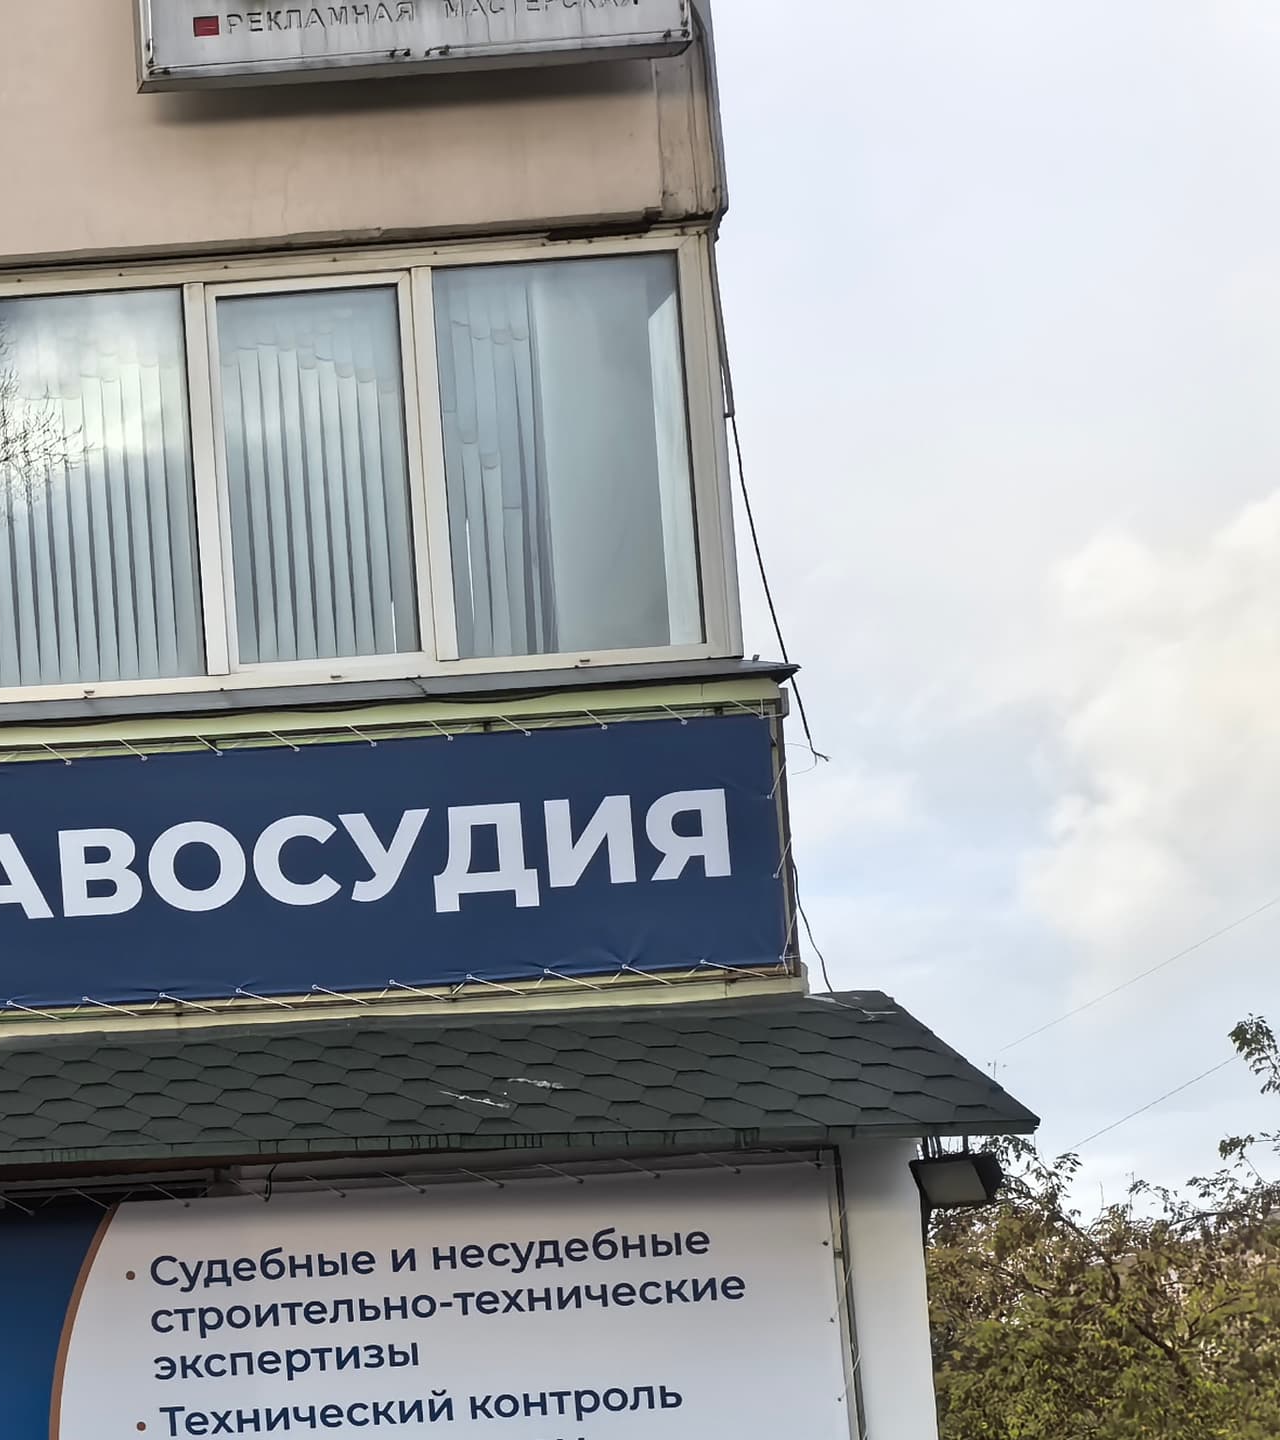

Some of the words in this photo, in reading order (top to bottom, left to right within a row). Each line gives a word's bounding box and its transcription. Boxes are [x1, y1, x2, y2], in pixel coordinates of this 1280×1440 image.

[226, 2, 414, 34] РЕКЛАМНАЯ
[150, 1247, 376, 1293] Судебные
[391, 1249, 416, 1273] и
[433, 1228, 711, 1275] несудебные
[150, 1271, 746, 1338] строительно-технические
[154, 1341, 420, 1380] экспертизы
[160, 1390, 454, 1437] Технический
[469, 1382, 683, 1421] контроль
